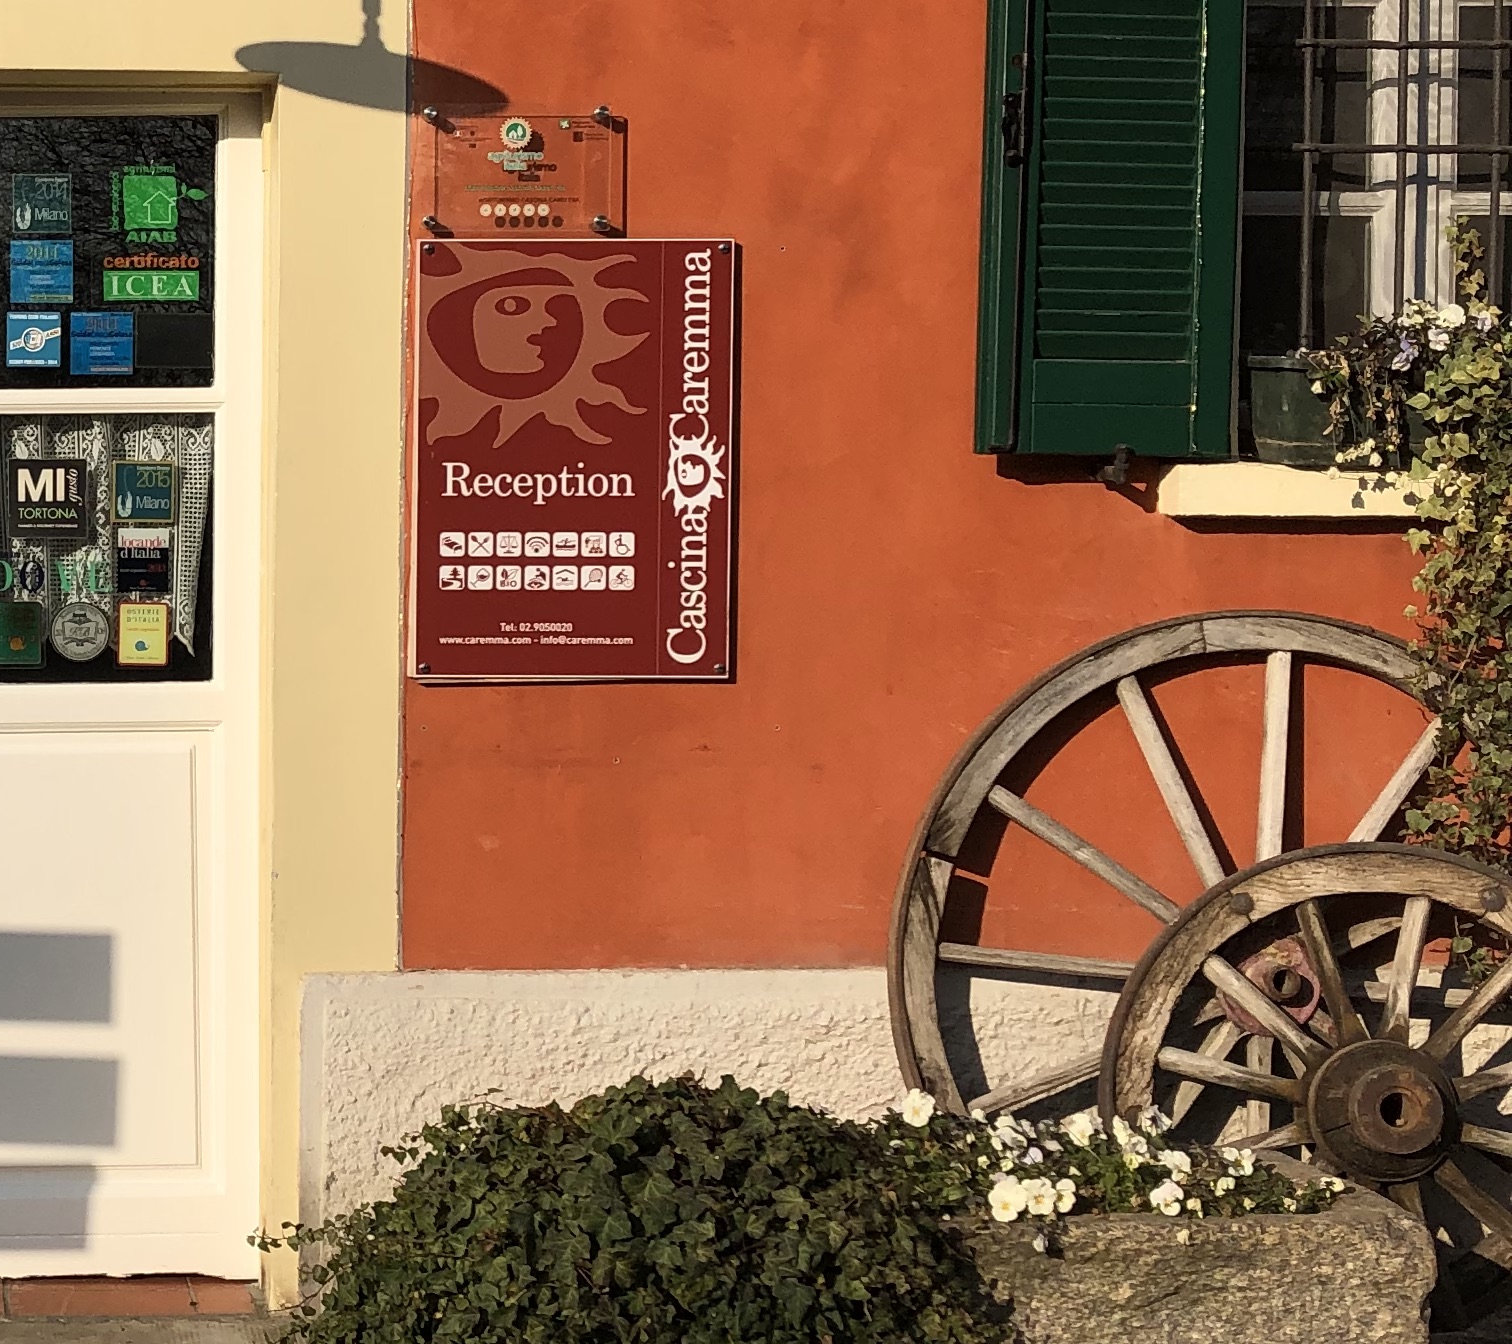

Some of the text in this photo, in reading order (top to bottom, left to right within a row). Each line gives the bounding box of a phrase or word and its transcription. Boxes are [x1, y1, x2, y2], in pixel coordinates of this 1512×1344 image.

[34, 207, 68, 221] Milano
[124, 230, 178, 243] AIAB
[103, 252, 200, 269] certificato
[110, 275, 193, 296] ICEA
[666, 248, 712, 665] Cascina Caremma
[17, 467, 66, 503] MI
[135, 470, 171, 488] 2015
[440, 461, 636, 505] Reception
[135, 495, 170, 510] Milano
[17, 507, 79, 520] TORTONA
[439, 635, 532, 645] www.caremma.com
[540, 634, 634, 645] info@caremma.com
